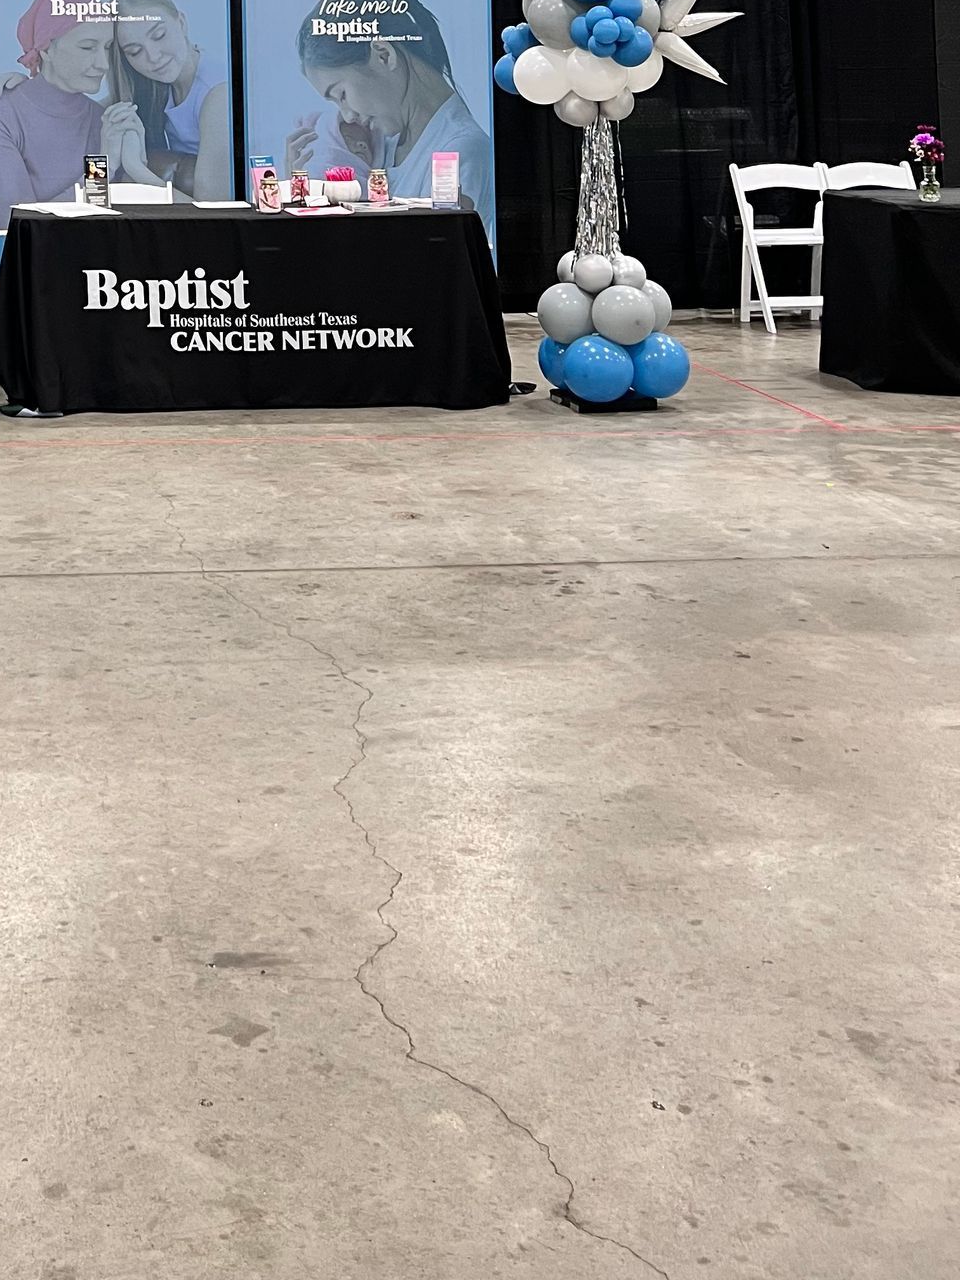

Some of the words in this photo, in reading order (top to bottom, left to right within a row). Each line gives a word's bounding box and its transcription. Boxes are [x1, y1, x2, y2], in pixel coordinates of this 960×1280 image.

[360, 0, 391, 15] me
[312, 18, 379, 42] Baptist
[82, 268, 251, 328] Baptist
[170, 314, 232, 330] Hospitals
[234, 313, 248, 327] of
[250, 313, 316, 327] Southeast
[318, 312, 358, 325] Texas
[170, 331, 275, 351] CANCER
[282, 328, 414, 350] NETWORK
